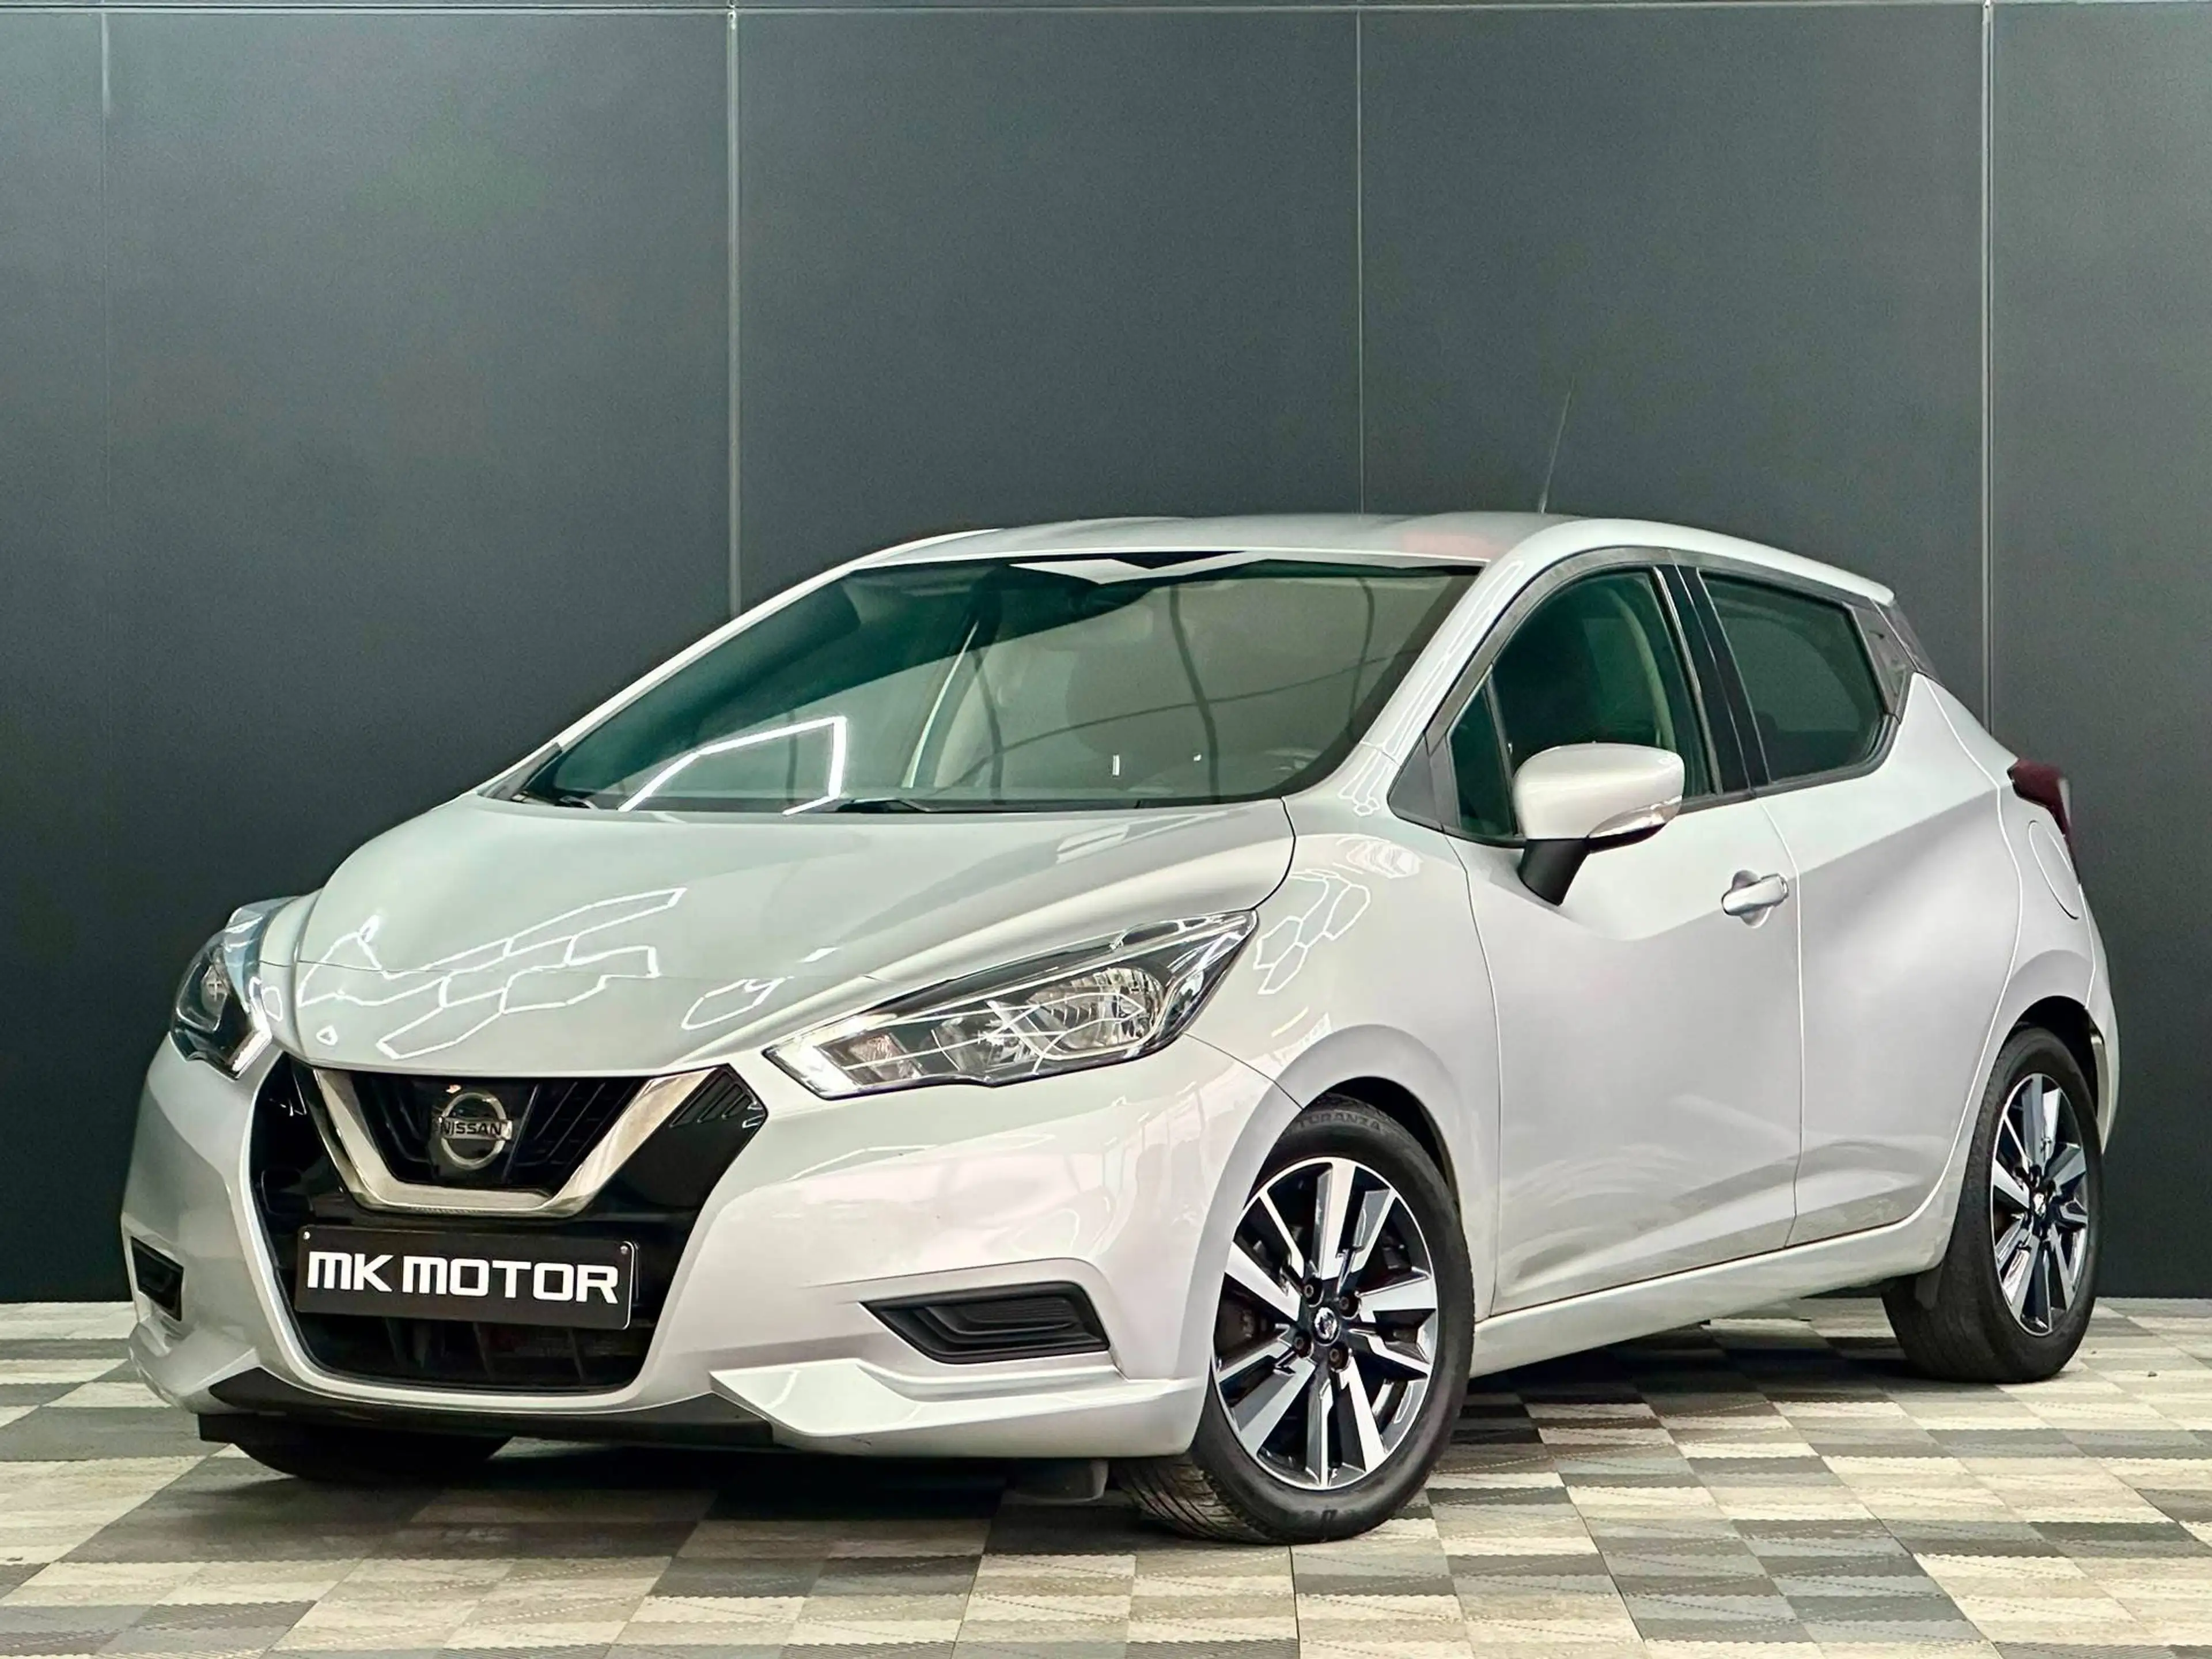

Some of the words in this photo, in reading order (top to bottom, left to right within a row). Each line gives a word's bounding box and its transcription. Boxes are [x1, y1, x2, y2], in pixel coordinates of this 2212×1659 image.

[440, 1122, 502, 1135] NISSAN
[307, 1251, 393, 1292] MK
[402, 1256, 618, 1304] MOTOR
